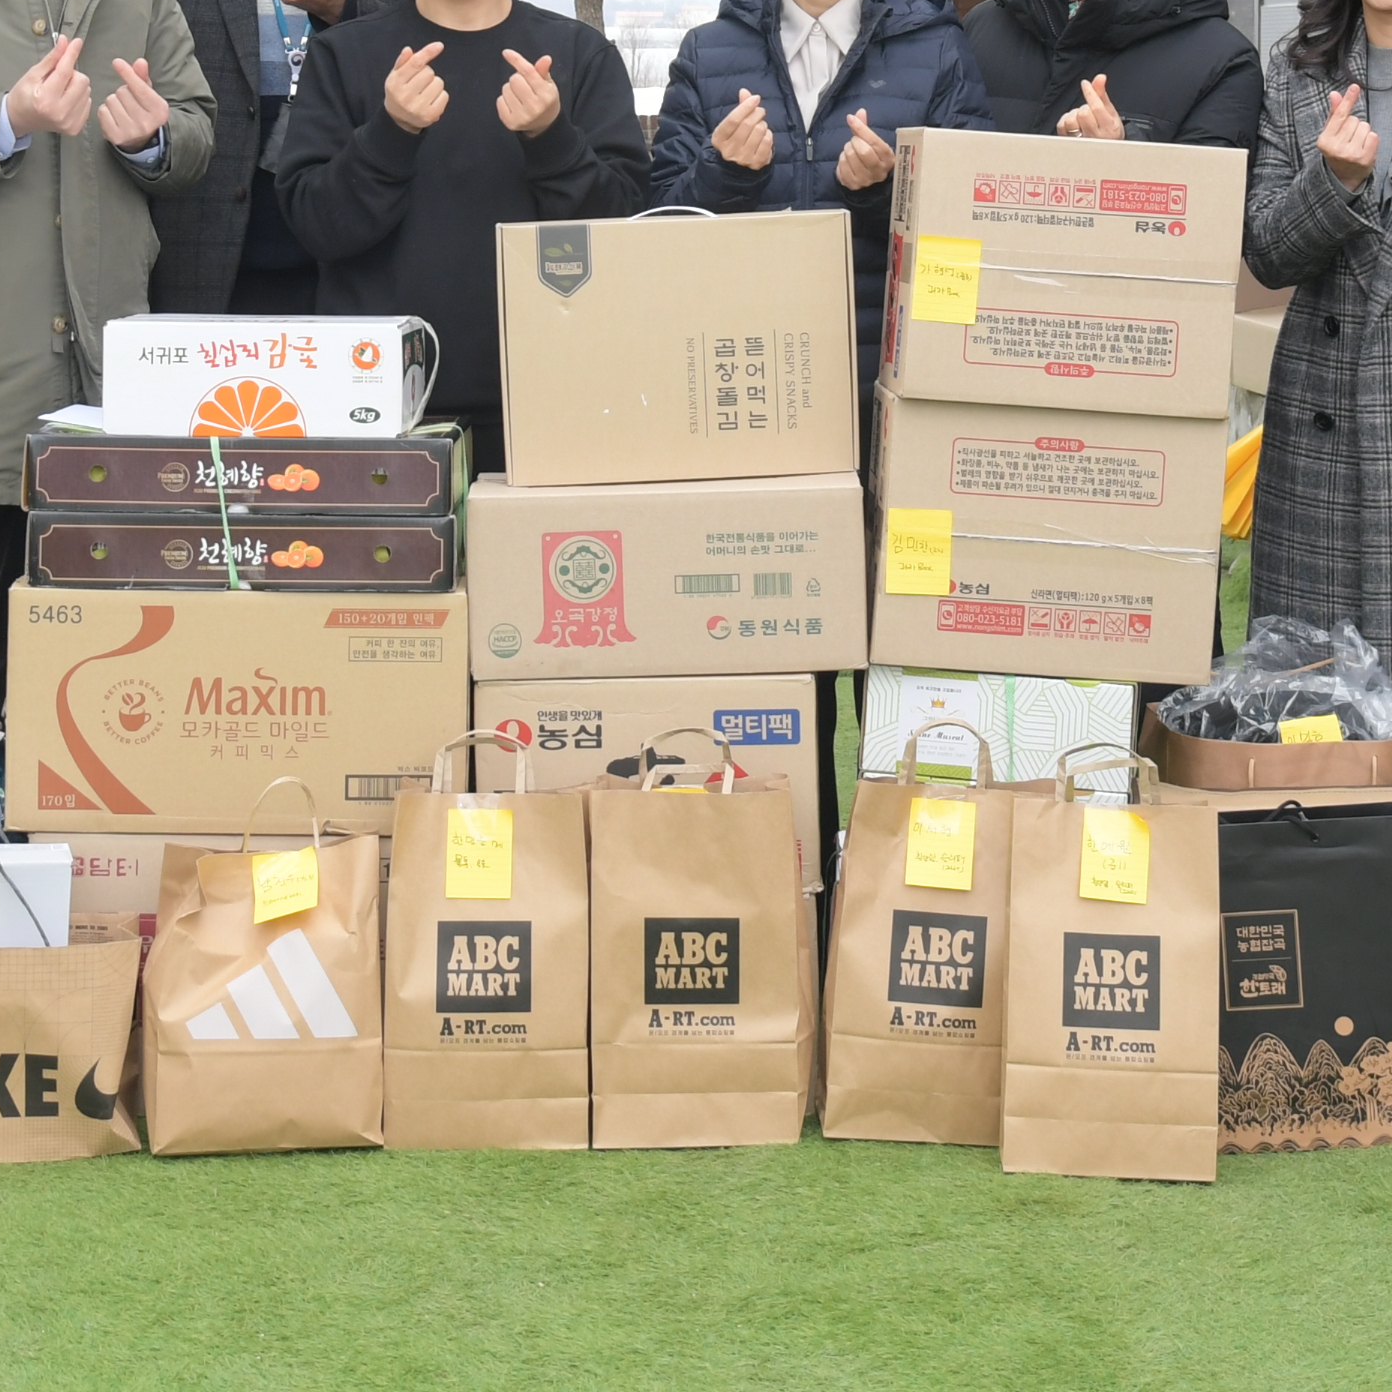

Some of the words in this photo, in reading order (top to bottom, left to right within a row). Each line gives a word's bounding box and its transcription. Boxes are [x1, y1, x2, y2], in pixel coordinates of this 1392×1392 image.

[1103, 182, 1167, 192] www.nongshim.com
[1103, 189, 1166, 202] 080-023-5181
[1136, 222, 1166, 234] 농심
[138, 346, 189, 365] 서귀포
[197, 339, 260, 368] 칠십리
[262, 332, 318, 369] 감귤
[686, 337, 695, 354] NO
[1003, 338, 1031, 348] 보관하지
[1035, 339, 1056, 349] 곳에는
[1059, 341, 1072, 350] 나는
[1076, 342, 1096, 352] 냄새가
[1100, 343, 1106, 352] 등
[1110, 344, 1123, 353] 약품
[783, 332, 795, 378] CRISPY
[798, 331, 812, 386] CRUNCH
[1037, 351, 1051, 360] 곳에
[1054, 352, 1074, 361] 건조한
[1078, 353, 1105, 363] 서늘하고
[1109, 355, 1129, 364] 피하고
[1132, 356, 1167, 366] 직사광선을
[1050, 364, 1089, 375] 주의사항
[714, 338, 739, 431] 곱창돌김
[744, 336, 768, 430] 뜯어먹는
[687, 355, 698, 435] PRESERVATIVES
[801, 388, 812, 409] and
[785, 380, 798, 430] SNACKS
[353, 409, 376, 422] 5kg
[1038, 438, 1080, 452] 주의사항
[962, 448, 997, 459] 직사광선을
[1000, 450, 1020, 460] 피하고
[1023, 452, 1051, 462] 서늘하고
[1054, 453, 1075, 463] 건조한
[1077, 455, 1091, 464] 곳에
[195, 460, 264, 489] 천혜향
[1006, 461, 1019, 471] 약품
[1022, 462, 1029, 471] 등
[1032, 463, 1053, 473] 냄새가
[1057, 465, 1070, 474] 나는
[1073, 466, 1093, 476] 곳에는
[1097, 467, 1125, 478] 보관하지
[706, 532, 775, 544] 한국전통식품을
[779, 531, 819, 541] 이어가는
[198, 537, 268, 565] 천혜향
[706, 545, 746, 556] 어머니의
[750, 545, 771, 555] 손맛
[959, 582, 990, 595] 농심
[28, 605, 82, 625] 5463
[338, 612, 407, 625] 150+20개입
[413, 612, 435, 625] 인팩
[551, 607, 618, 623] 오곡강정
[957, 614, 1022, 626] 080-023-5181
[738, 617, 823, 637] 동원식품
[957, 623, 1022, 633] www.nongshim.com
[494, 635, 517, 643] HACCP
[382, 650, 415, 659] 생각하는
[103, 678, 135, 701] BETTER
[138, 678, 164, 703] BEANS
[184, 670, 326, 716] Maxim
[537, 710, 568, 721] 인생을
[570, 710, 603, 721] 맛있게
[103, 720, 131, 745] BETTER
[134, 720, 164, 745] COFFEE
[180, 720, 261, 742] 모카골드
[269, 720, 330, 743] 마일드
[721, 714, 793, 741] 멀티팩
[537, 723, 603, 751] 농심
[40, 793, 76, 808] 170입
[1236, 924, 1285, 938] 대한민국
[447, 935, 520, 970] ABC
[655, 932, 728, 965] ABC
[901, 925, 975, 964] ABC
[1237, 938, 1286, 953] 농협잡곡
[1074, 948, 1149, 986] ABC
[447, 972, 520, 997] MART
[655, 967, 728, 989] MART
[899, 963, 974, 991] MART
[1239, 978, 1287, 998] 한토래
[1074, 986, 1149, 1013] MART
